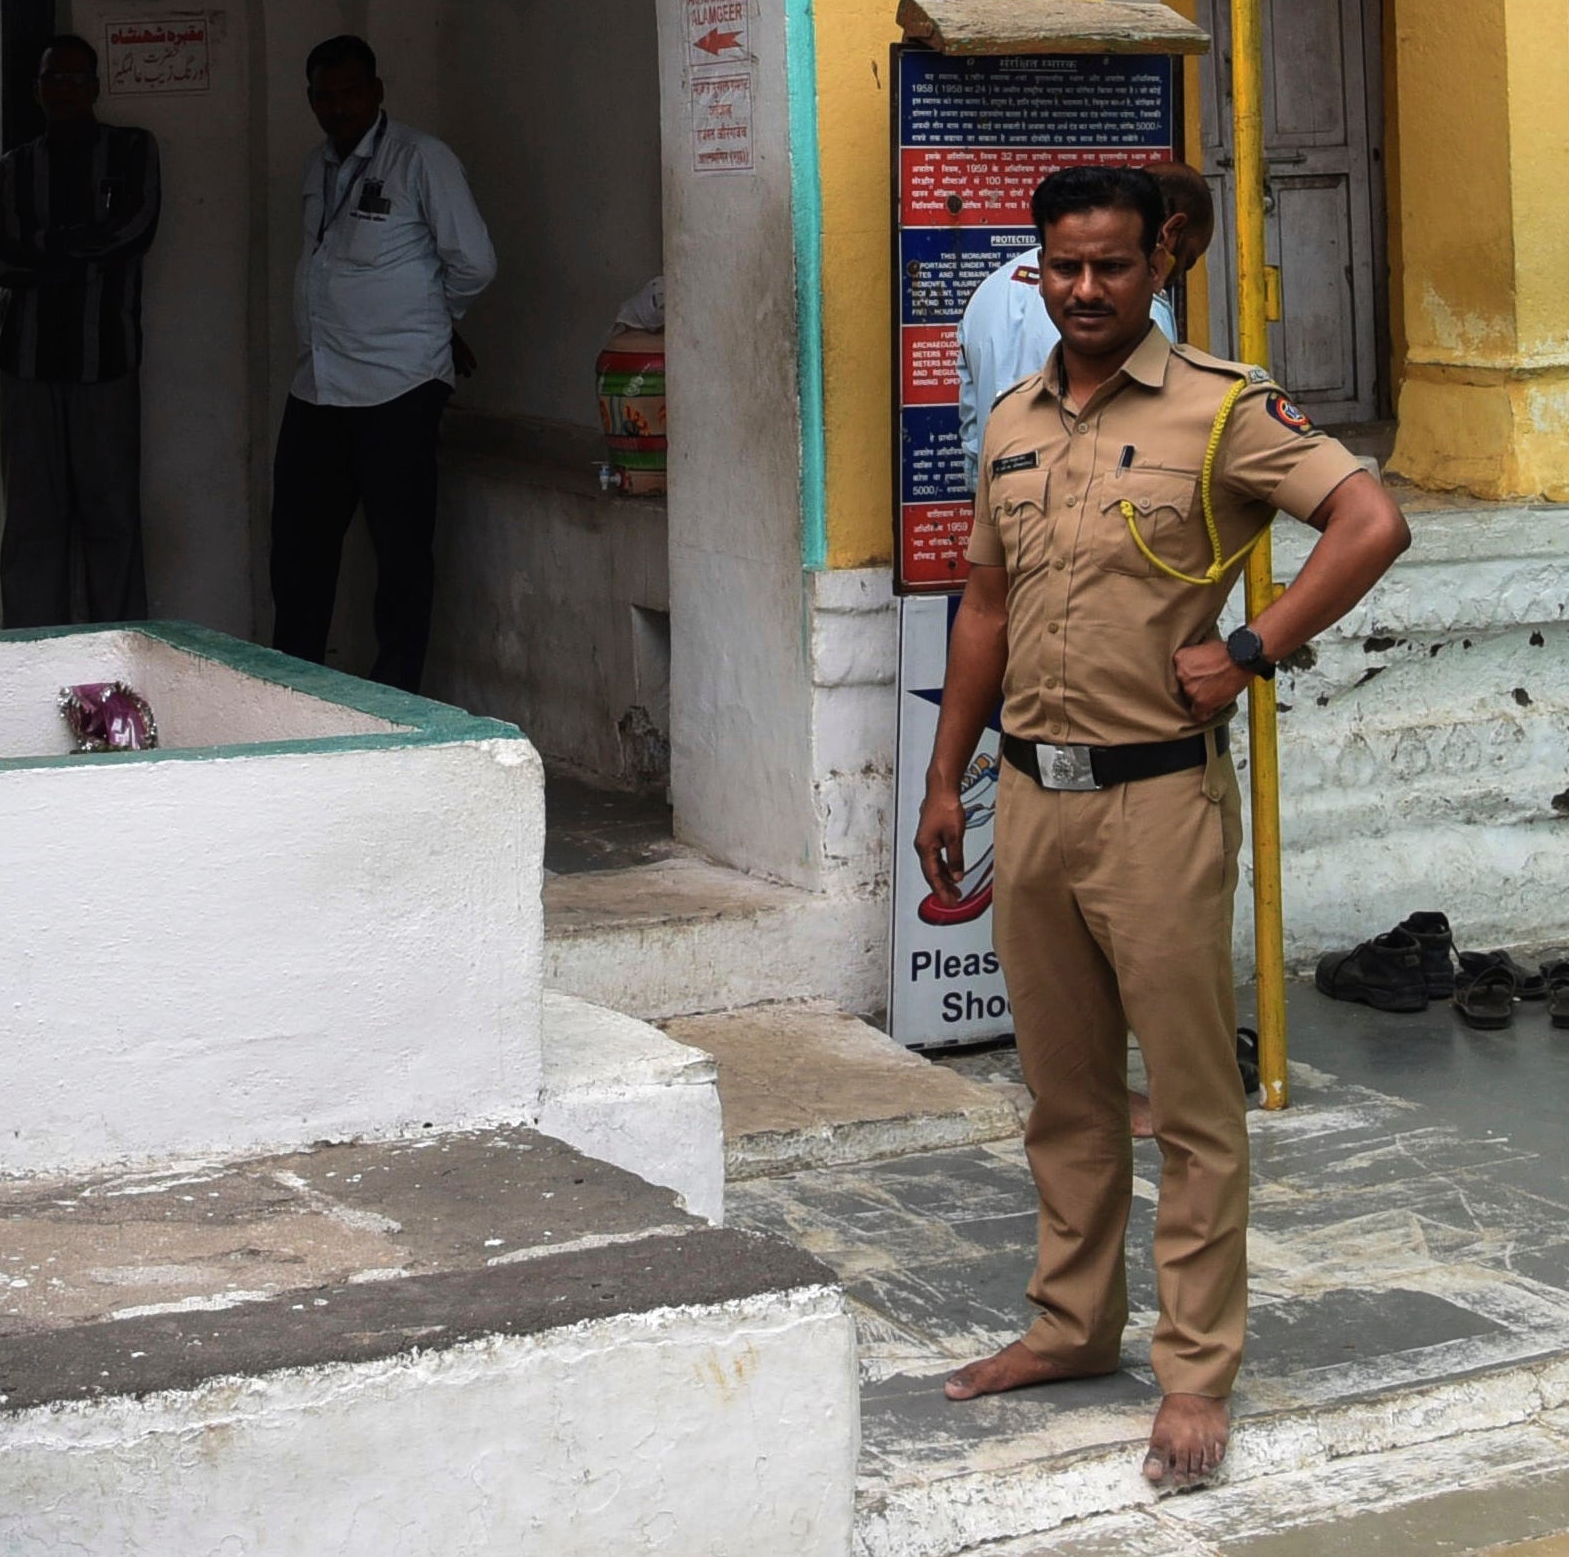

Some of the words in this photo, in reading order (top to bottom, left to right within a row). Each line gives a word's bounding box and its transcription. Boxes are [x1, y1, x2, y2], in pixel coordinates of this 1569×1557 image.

[692, 3, 742, 26] ALAMGEER
[991, 235, 1037, 244] PROTECTED
[919, 262, 957, 270] PORTANCE
[946, 350, 960, 358] FRO
[941, 359, 956, 367] NEA
[913, 485, 943, 496] 5000/-
[911, 949, 999, 982] Pleas
[942, 990, 1012, 1023] Sho
